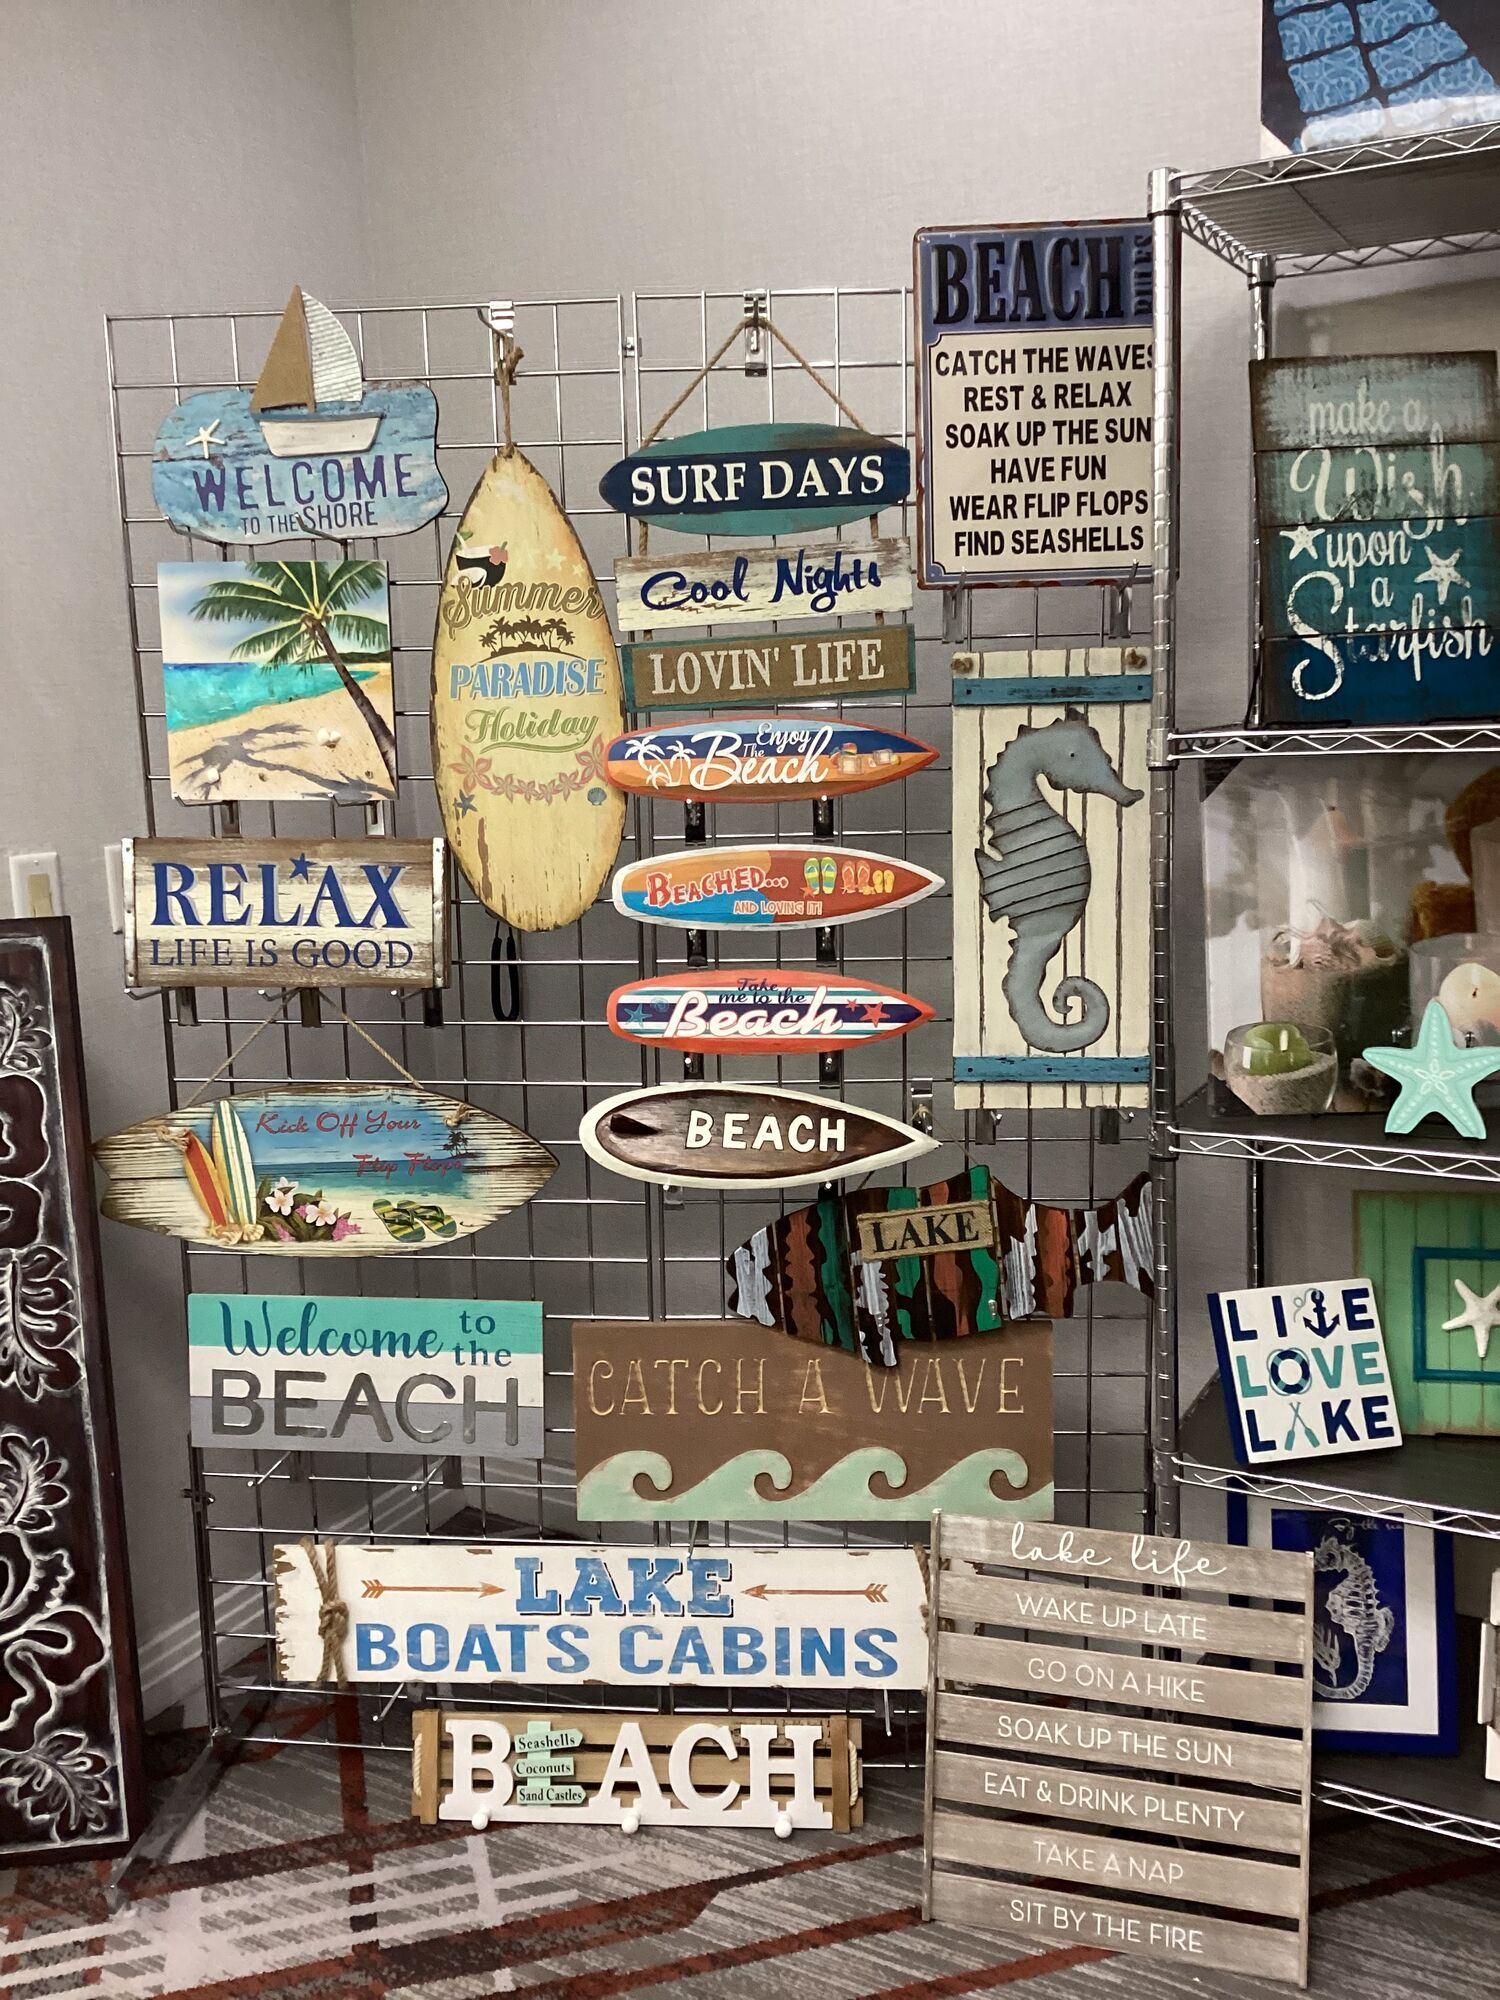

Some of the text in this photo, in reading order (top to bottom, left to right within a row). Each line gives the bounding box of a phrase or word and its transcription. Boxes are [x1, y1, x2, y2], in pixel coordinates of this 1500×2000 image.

[933, 236, 1124, 325] BEACH
[935, 349, 1016, 376] CATCH
[1023, 347, 1069, 373] THE
[964, 381, 1132, 412] REST & RELAX
[1309, 376, 1428, 436] make a
[945, 416, 1152, 449] SOAK UP THE SUN
[192, 453, 418, 512] WELCOME
[630, 454, 885, 507] SURF DAYS
[990, 454, 1107, 484] HAVE FUN
[1289, 421, 1468, 540] Wish
[240, 500, 378, 535] TO THE SHORE
[950, 489, 1149, 521] WEAR FLIP FLOPS
[954, 525, 1144, 557] FIND SEASHELLS
[1325, 529, 1412, 588] upon
[443, 575, 604, 630] Summer
[640, 556, 750, 611] Cool
[1370, 576, 1395, 607] a
[1286, 570, 1494, 701] Starfish
[450, 658, 607, 699] PARADISE
[648, 638, 885, 695] LOVIN' LIFE
[463, 706, 599, 754] Holiday
[743, 743, 766, 758] The
[756, 721, 812, 753] Enjoy
[689, 725, 834, 791] Beach
[150, 861, 415, 929] RELAX
[733, 900, 823, 916] AND LOVING IT!
[150, 937, 414, 969] LIFE IS GOOD
[718, 987, 807, 1006] me to the
[736, 977, 779, 992] Take
[662, 985, 844, 1039] Beach
[255, 1109, 421, 1139] Kick Off Your
[685, 1109, 847, 1153] BEACH
[352, 1153, 399, 1180] Flip
[872, 1210, 980, 1254] LAKE
[219, 1300, 497, 1359] Welcome to
[452, 1340, 513, 1368] the
[1236, 1341, 1386, 1399] LOVE
[211, 1368, 520, 1447] BEACH
[589, 1357, 1025, 1417] CATCH A WAVE
[1011, 1521, 1228, 1588] lake life
[514, 1556, 736, 1619] LAKE
[1015, 1592, 1208, 1641] WAKE UP LATE
[354, 1622, 901, 1679] BOATS CABINS
[1027, 1657, 1207, 1704] GO ON A HIKE
[517, 1732, 577, 1751] Seashells
[997, 1715, 1233, 1768] SOAK UP THE SUN
[515, 1763, 573, 1776] Coconuts
[518, 1787, 584, 1802] Sand Castles
[983, 1770, 1246, 1832] EAT & DRINK PLENTY
[1032, 1840, 1185, 1885] TAKE A NAP
[1009, 1898, 1205, 1954] SIT BY THE FIRE
